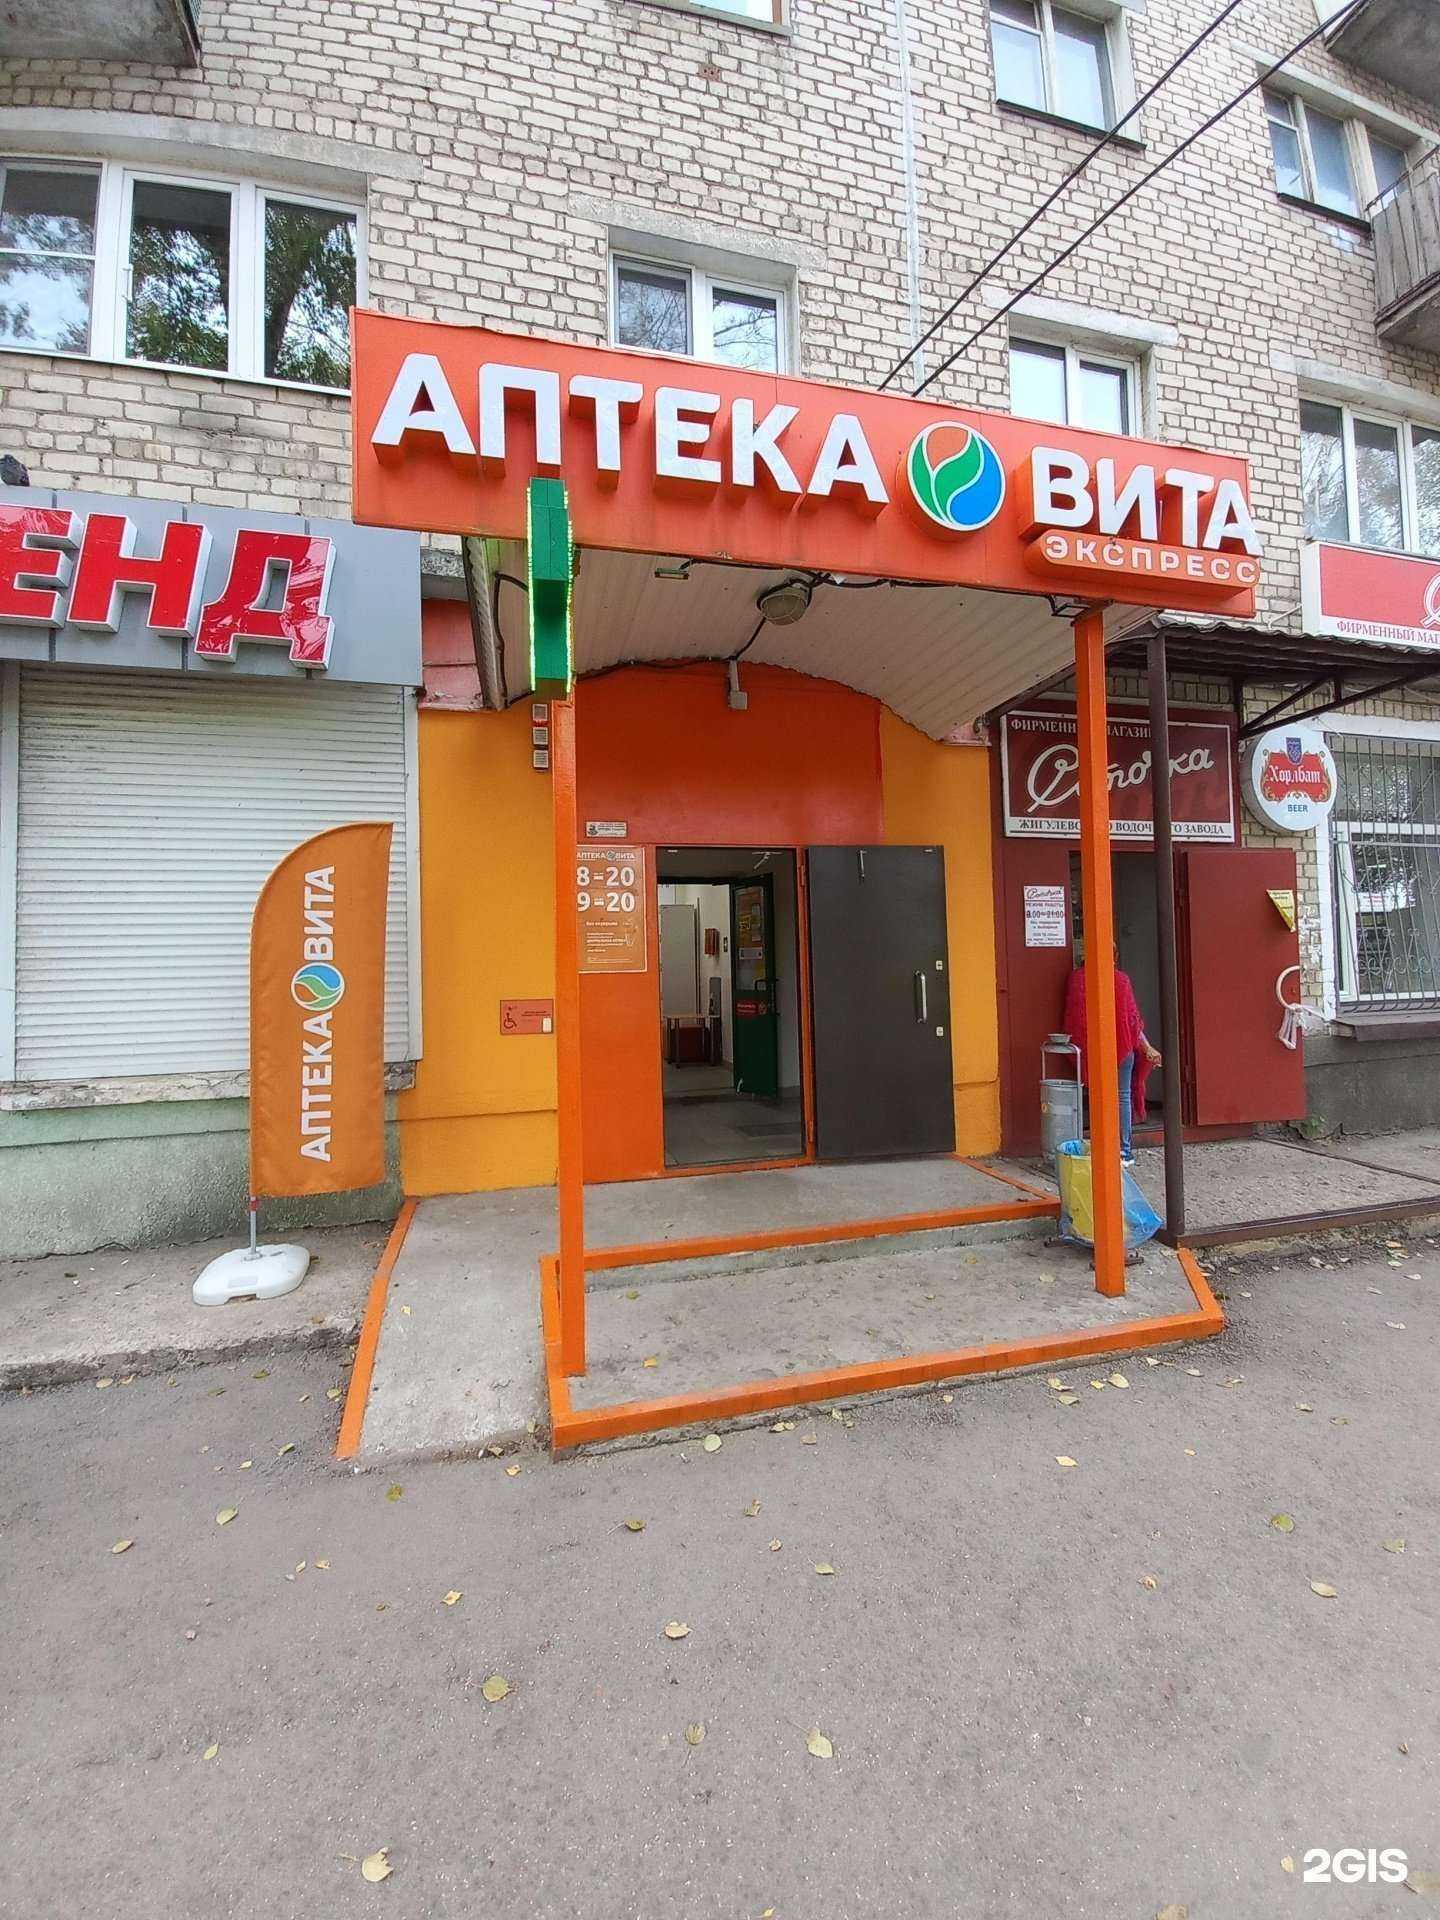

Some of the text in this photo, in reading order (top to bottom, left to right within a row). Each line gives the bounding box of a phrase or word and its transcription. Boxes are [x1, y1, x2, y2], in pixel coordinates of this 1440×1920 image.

[371, 352, 1264, 555] АПТЕКА ВИТА
[1045, 535, 1256, 583] ЭКСПРЕСС
[1337, 620, 1415, 641] ФИРМЕННЫЙ
[1011, 718, 1152, 738] ФИРМЕНН АГАЗИ
[1287, 804, 1308, 813] BEER
[1115, 822, 1182, 833] ВОДОЧО
[1184, 824, 1225, 834] ЗАВОДА
[301, 864, 336, 1162] АПТЕКА ВИТА
